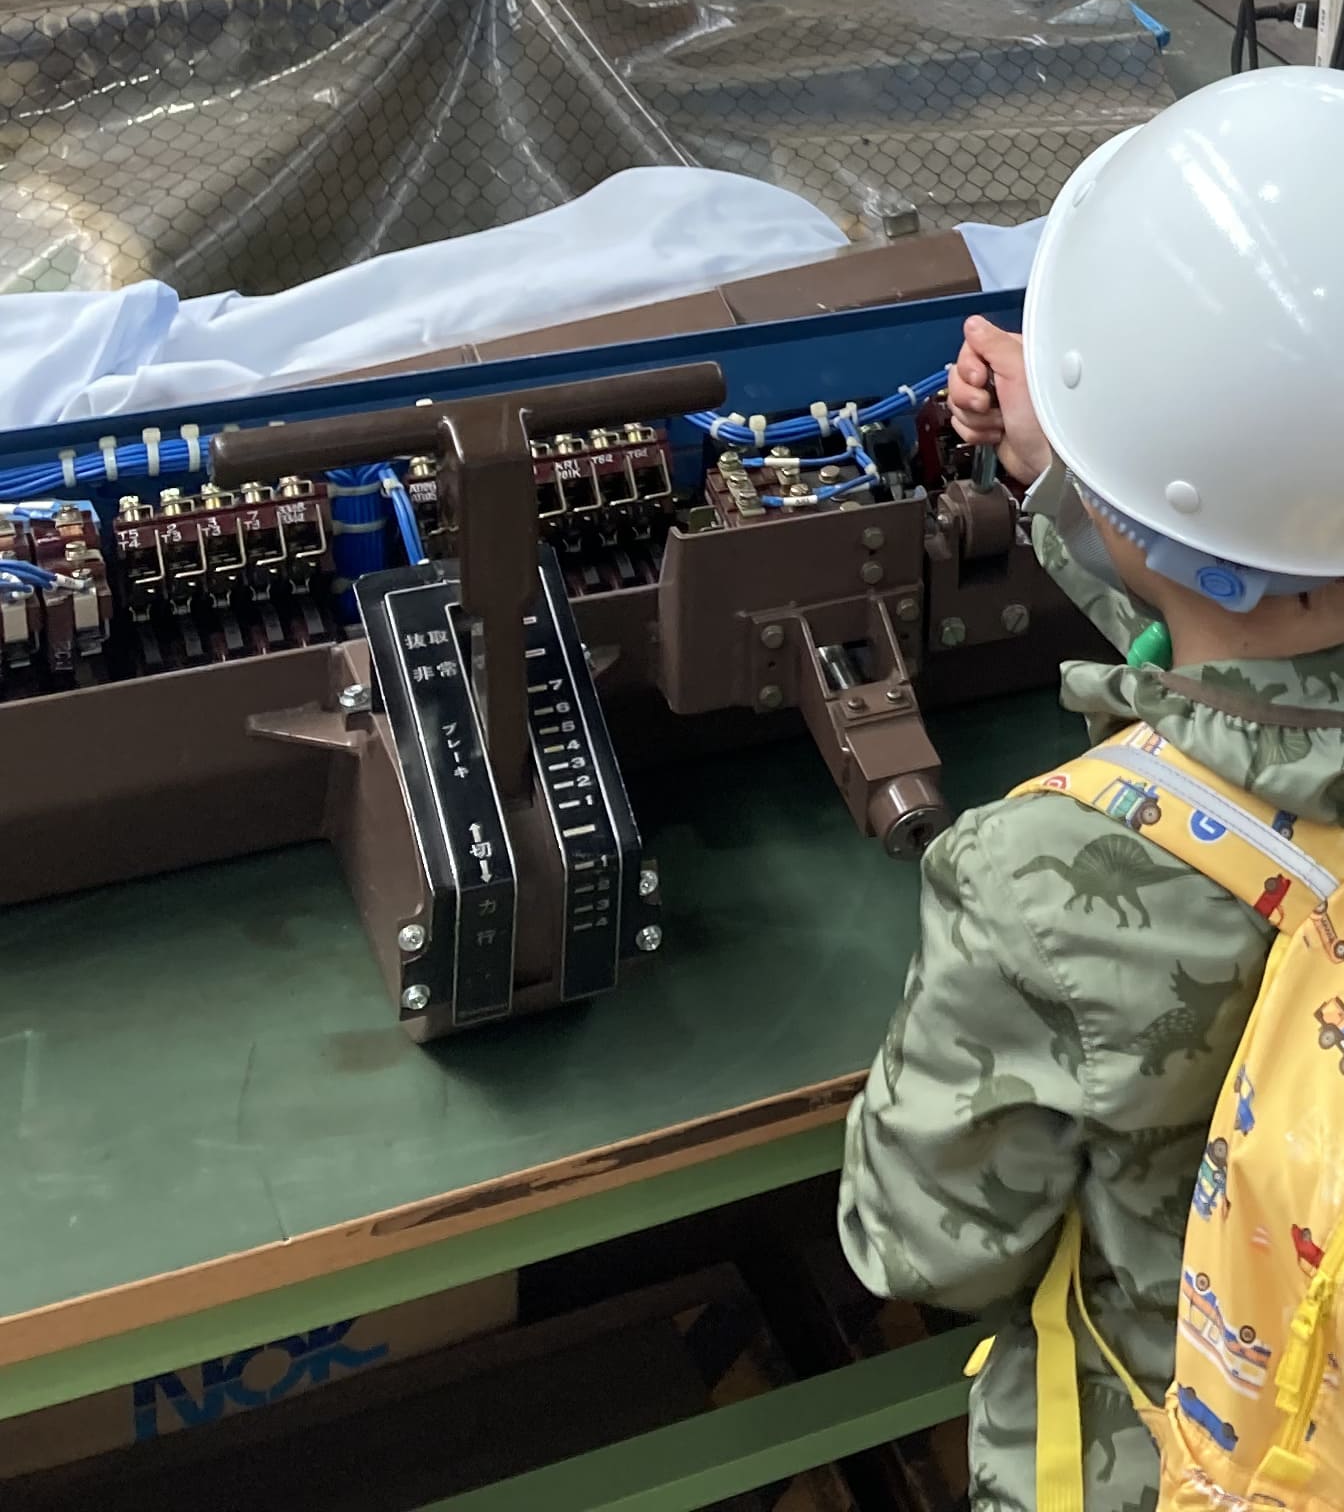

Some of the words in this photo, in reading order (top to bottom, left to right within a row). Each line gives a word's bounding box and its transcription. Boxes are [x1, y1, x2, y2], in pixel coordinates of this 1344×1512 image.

[117, 528, 140, 541] T5
[118, 539, 142, 551] T4
[405, 629, 449, 651] 抜取
[412, 660, 458, 682] 非常
[549, 678, 563, 692] 7
[556, 701, 570, 714] 6
[561, 720, 575, 733] 5
[567, 739, 582, 752] 4
[571, 756, 586, 769] 3
[576, 775, 592, 788] 2
[585, 794, 595, 806] 1
[469, 841, 493, 859] 切
[598, 854, 609, 868] 1
[133, 1318, 389, 1444] NOK
